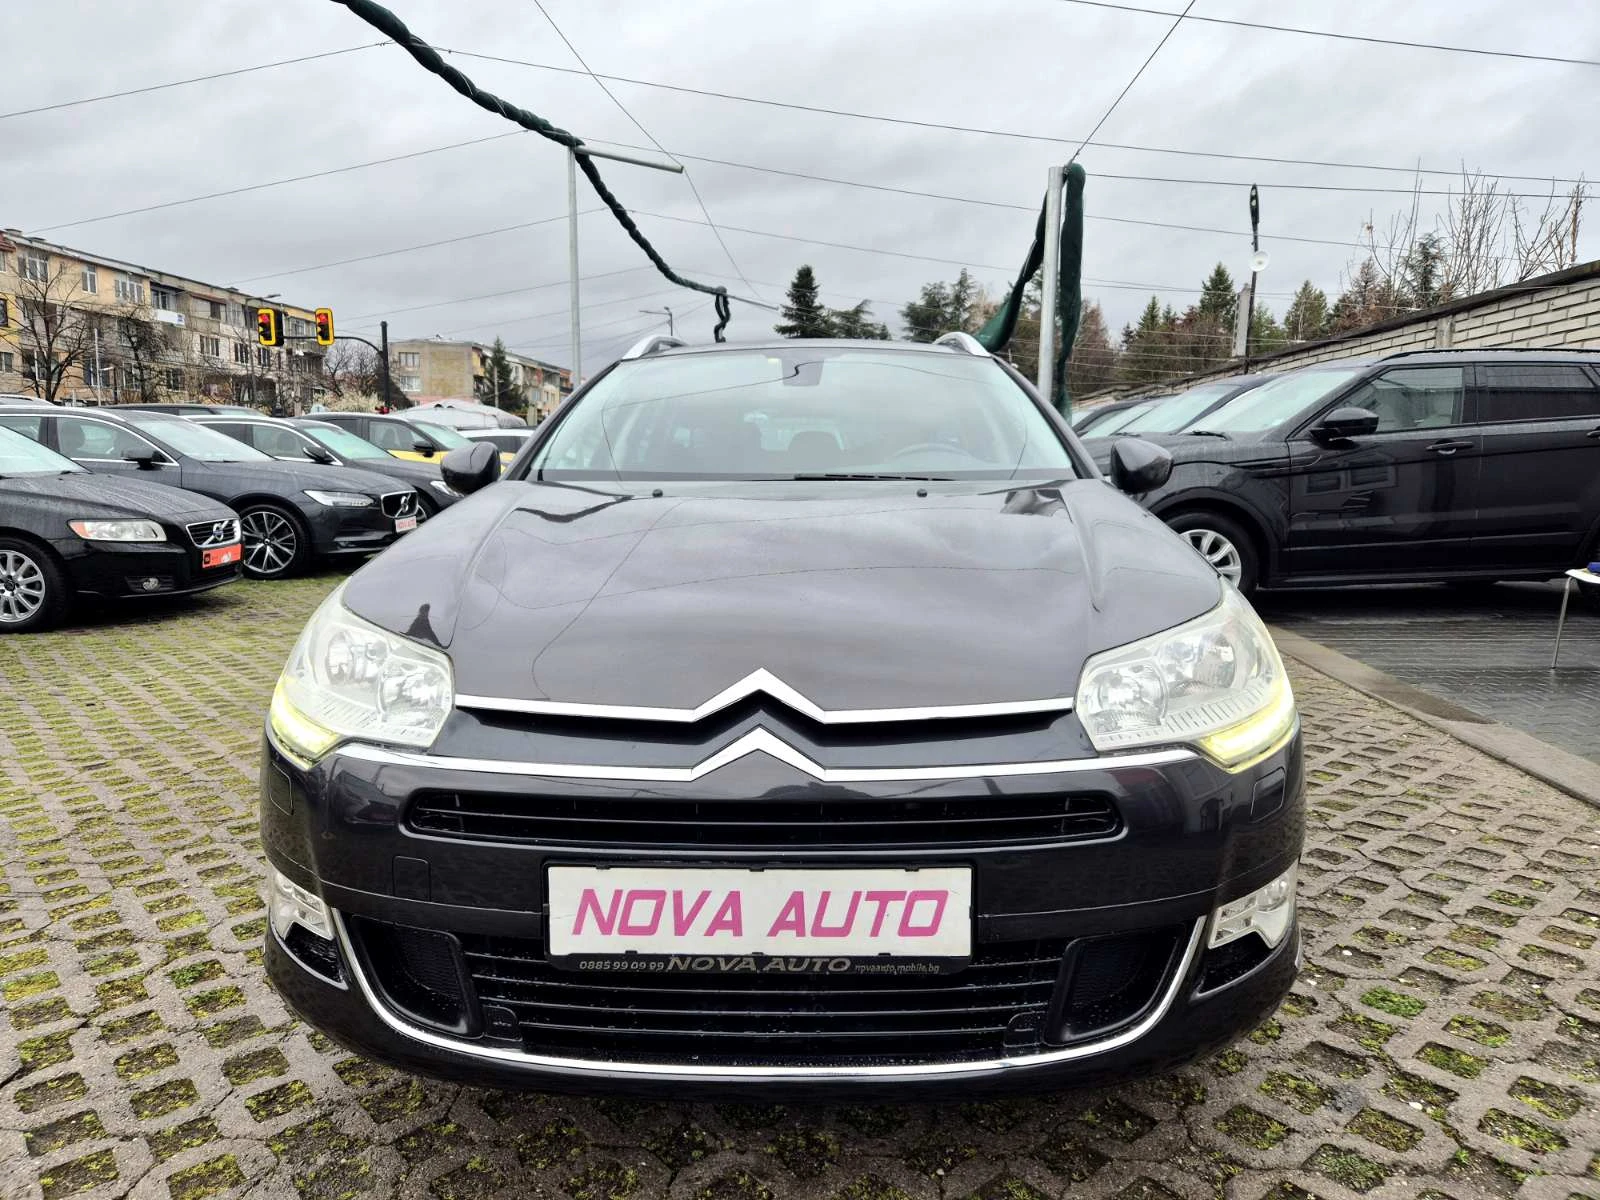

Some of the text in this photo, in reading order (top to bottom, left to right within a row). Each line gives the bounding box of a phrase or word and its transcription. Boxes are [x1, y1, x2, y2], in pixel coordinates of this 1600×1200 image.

[572, 888, 949, 938] NOVA AUTO
[579, 960, 611, 970] 0885
[613, 960, 628, 970] 99
[666, 956, 757, 971] NOVA
[762, 957, 851, 972] AUTO
